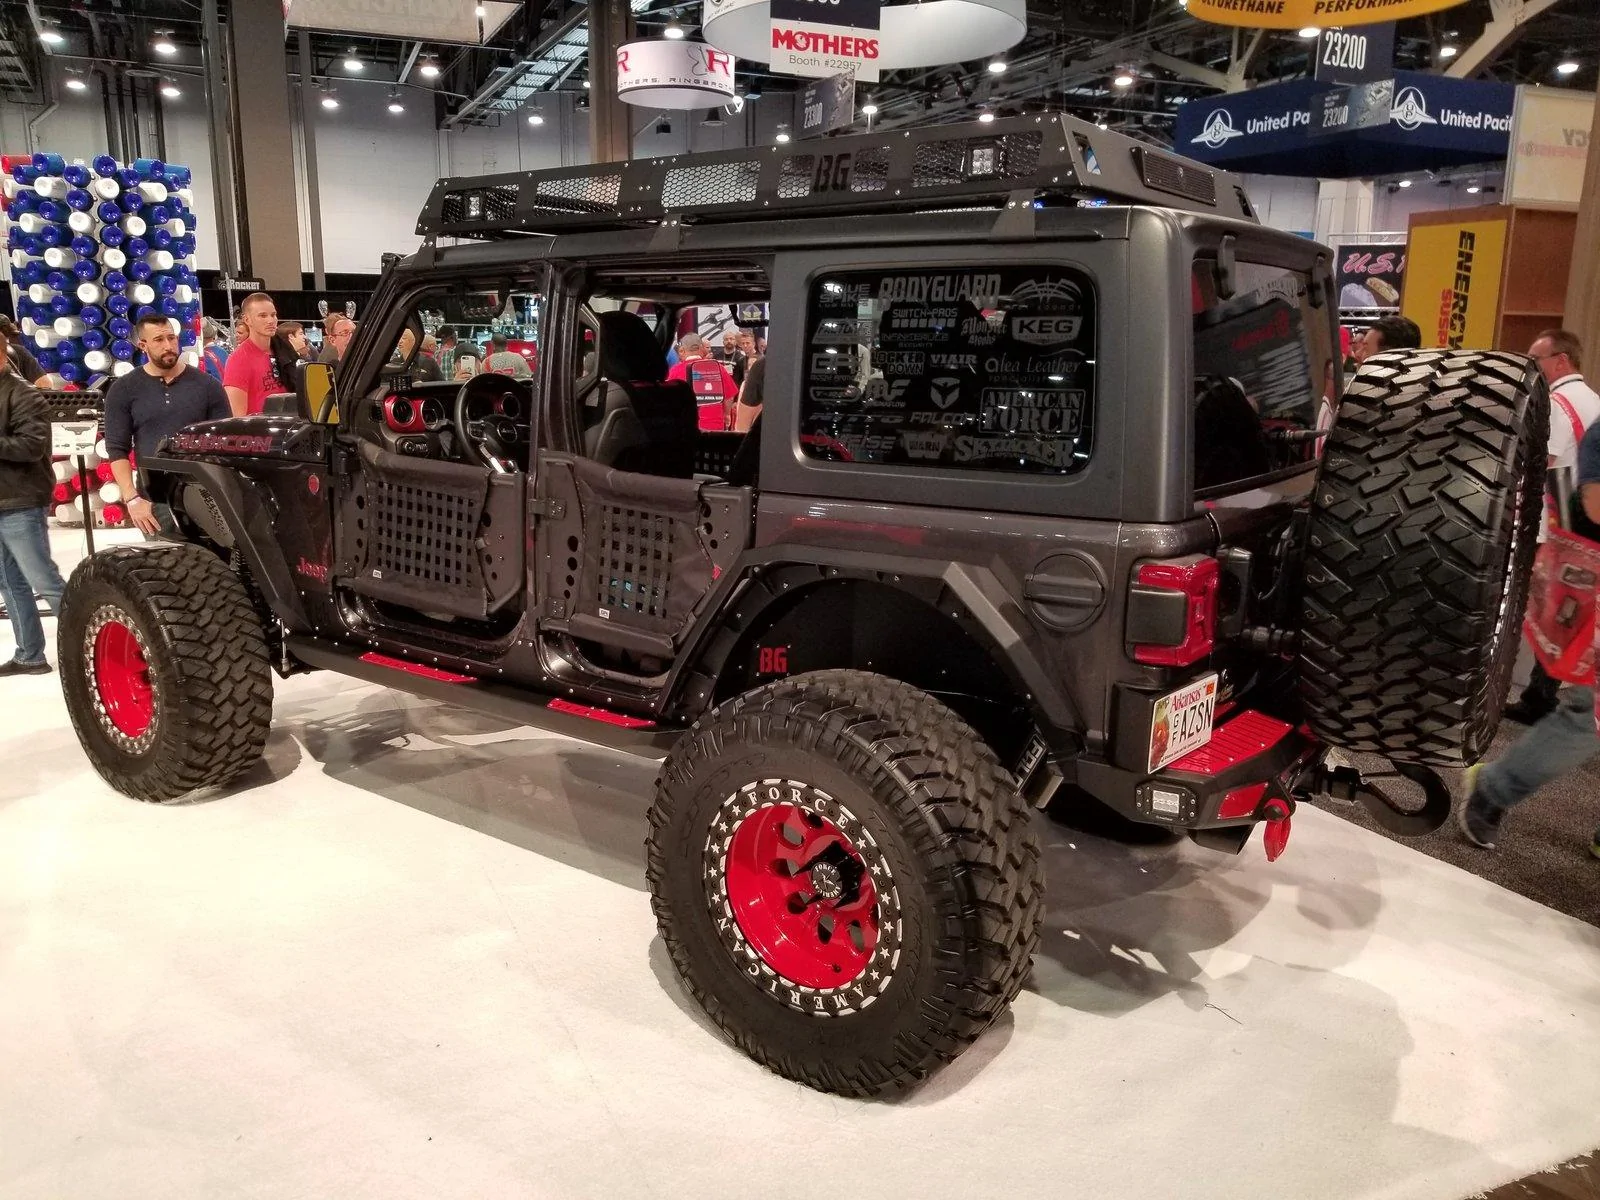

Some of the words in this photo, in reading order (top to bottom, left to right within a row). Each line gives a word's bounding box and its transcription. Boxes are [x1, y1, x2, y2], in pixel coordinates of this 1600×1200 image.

[772, 28, 879, 59] MOTHERS
[1323, 31, 1367, 70] 23200
[789, 54, 820, 68] Booth
[824, 58, 862, 71] #22957
[1246, 111, 1290, 134] United
[1322, 105, 1349, 128] 23200
[1440, 108, 1482, 129] United
[813, 152, 852, 193] BG
[227, 278, 260, 290] ROCKET
[878, 273, 1002, 305] BODYGUARD
[1018, 319, 1074, 334] KEG
[887, 363, 924, 375] DOWN
[930, 353, 978, 365] VIAIR
[1025, 356, 1082, 374] Leather
[982, 390, 1083, 409] AMERICAN
[983, 406, 1079, 433] FORCE
[759, 647, 788, 673] BG
[1179, 697, 1214, 743] AZSN
[748, 787, 849, 829] FORCE
[717, 916, 866, 1009] AMERICAN
